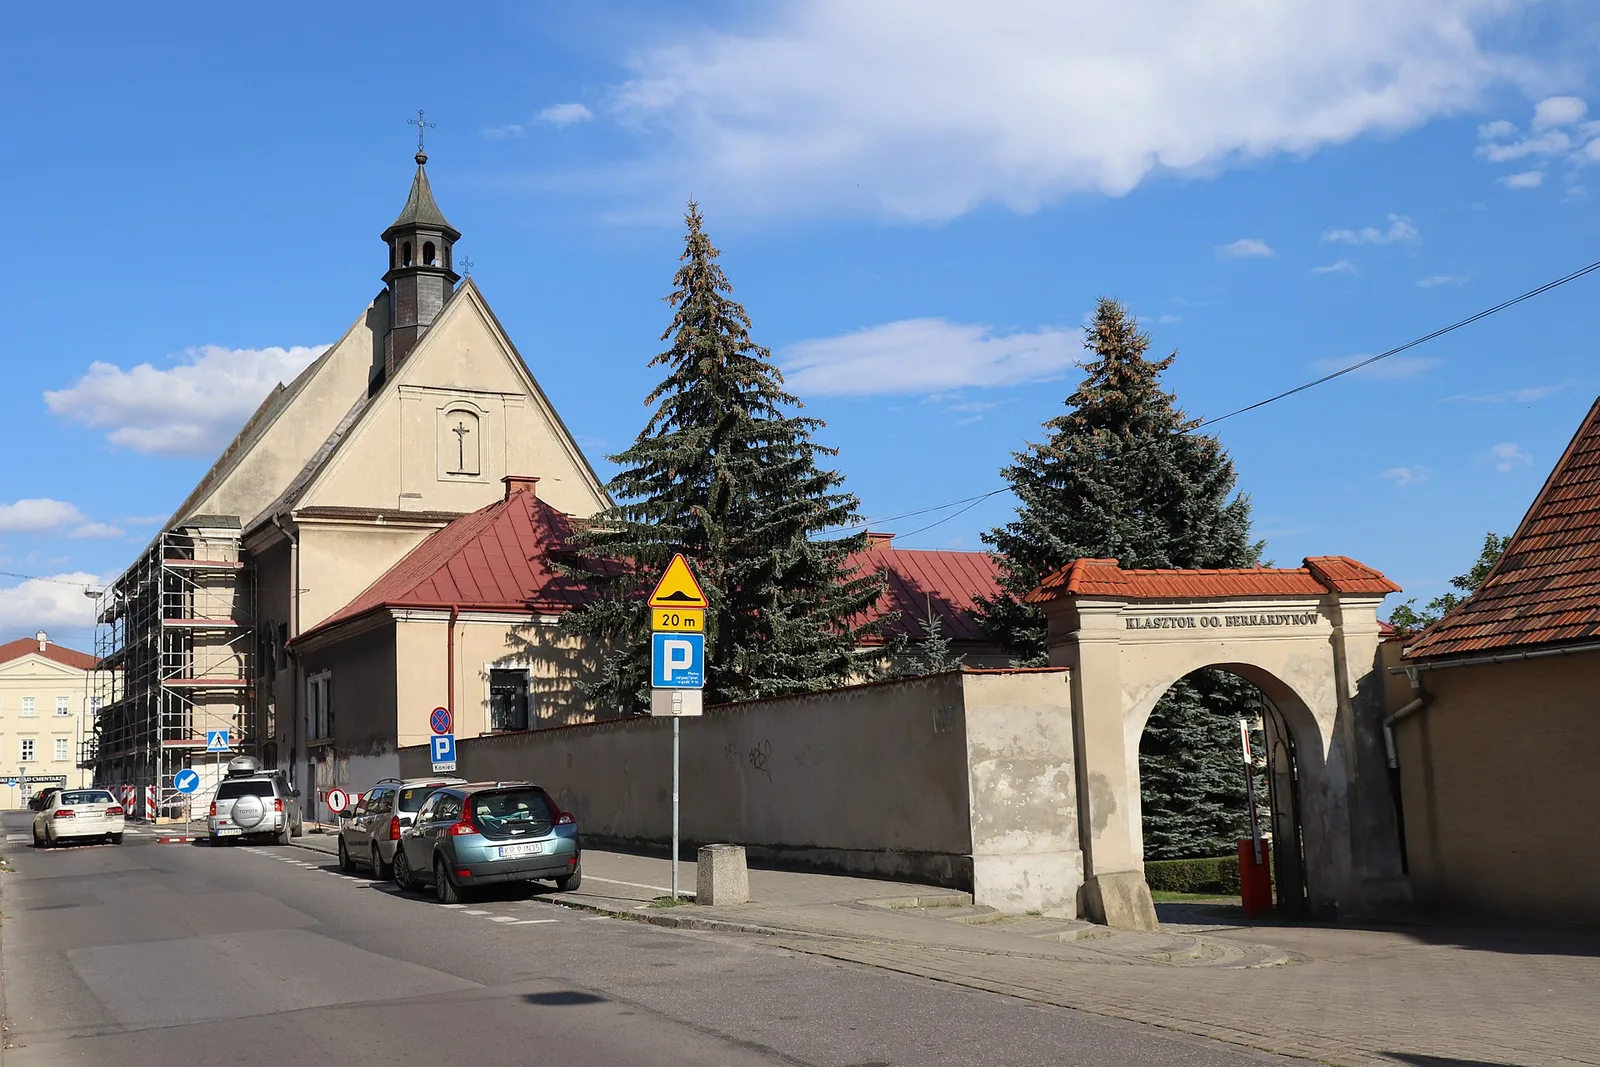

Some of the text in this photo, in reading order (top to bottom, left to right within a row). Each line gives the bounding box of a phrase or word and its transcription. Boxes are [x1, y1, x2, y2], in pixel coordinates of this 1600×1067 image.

[662, 614, 695, 627] 20 m
[1125, 611, 1318, 629] KLASZTOR OO. BERNARDYNÓW
[664, 640, 693, 681] P
[435, 738, 450, 760] P
